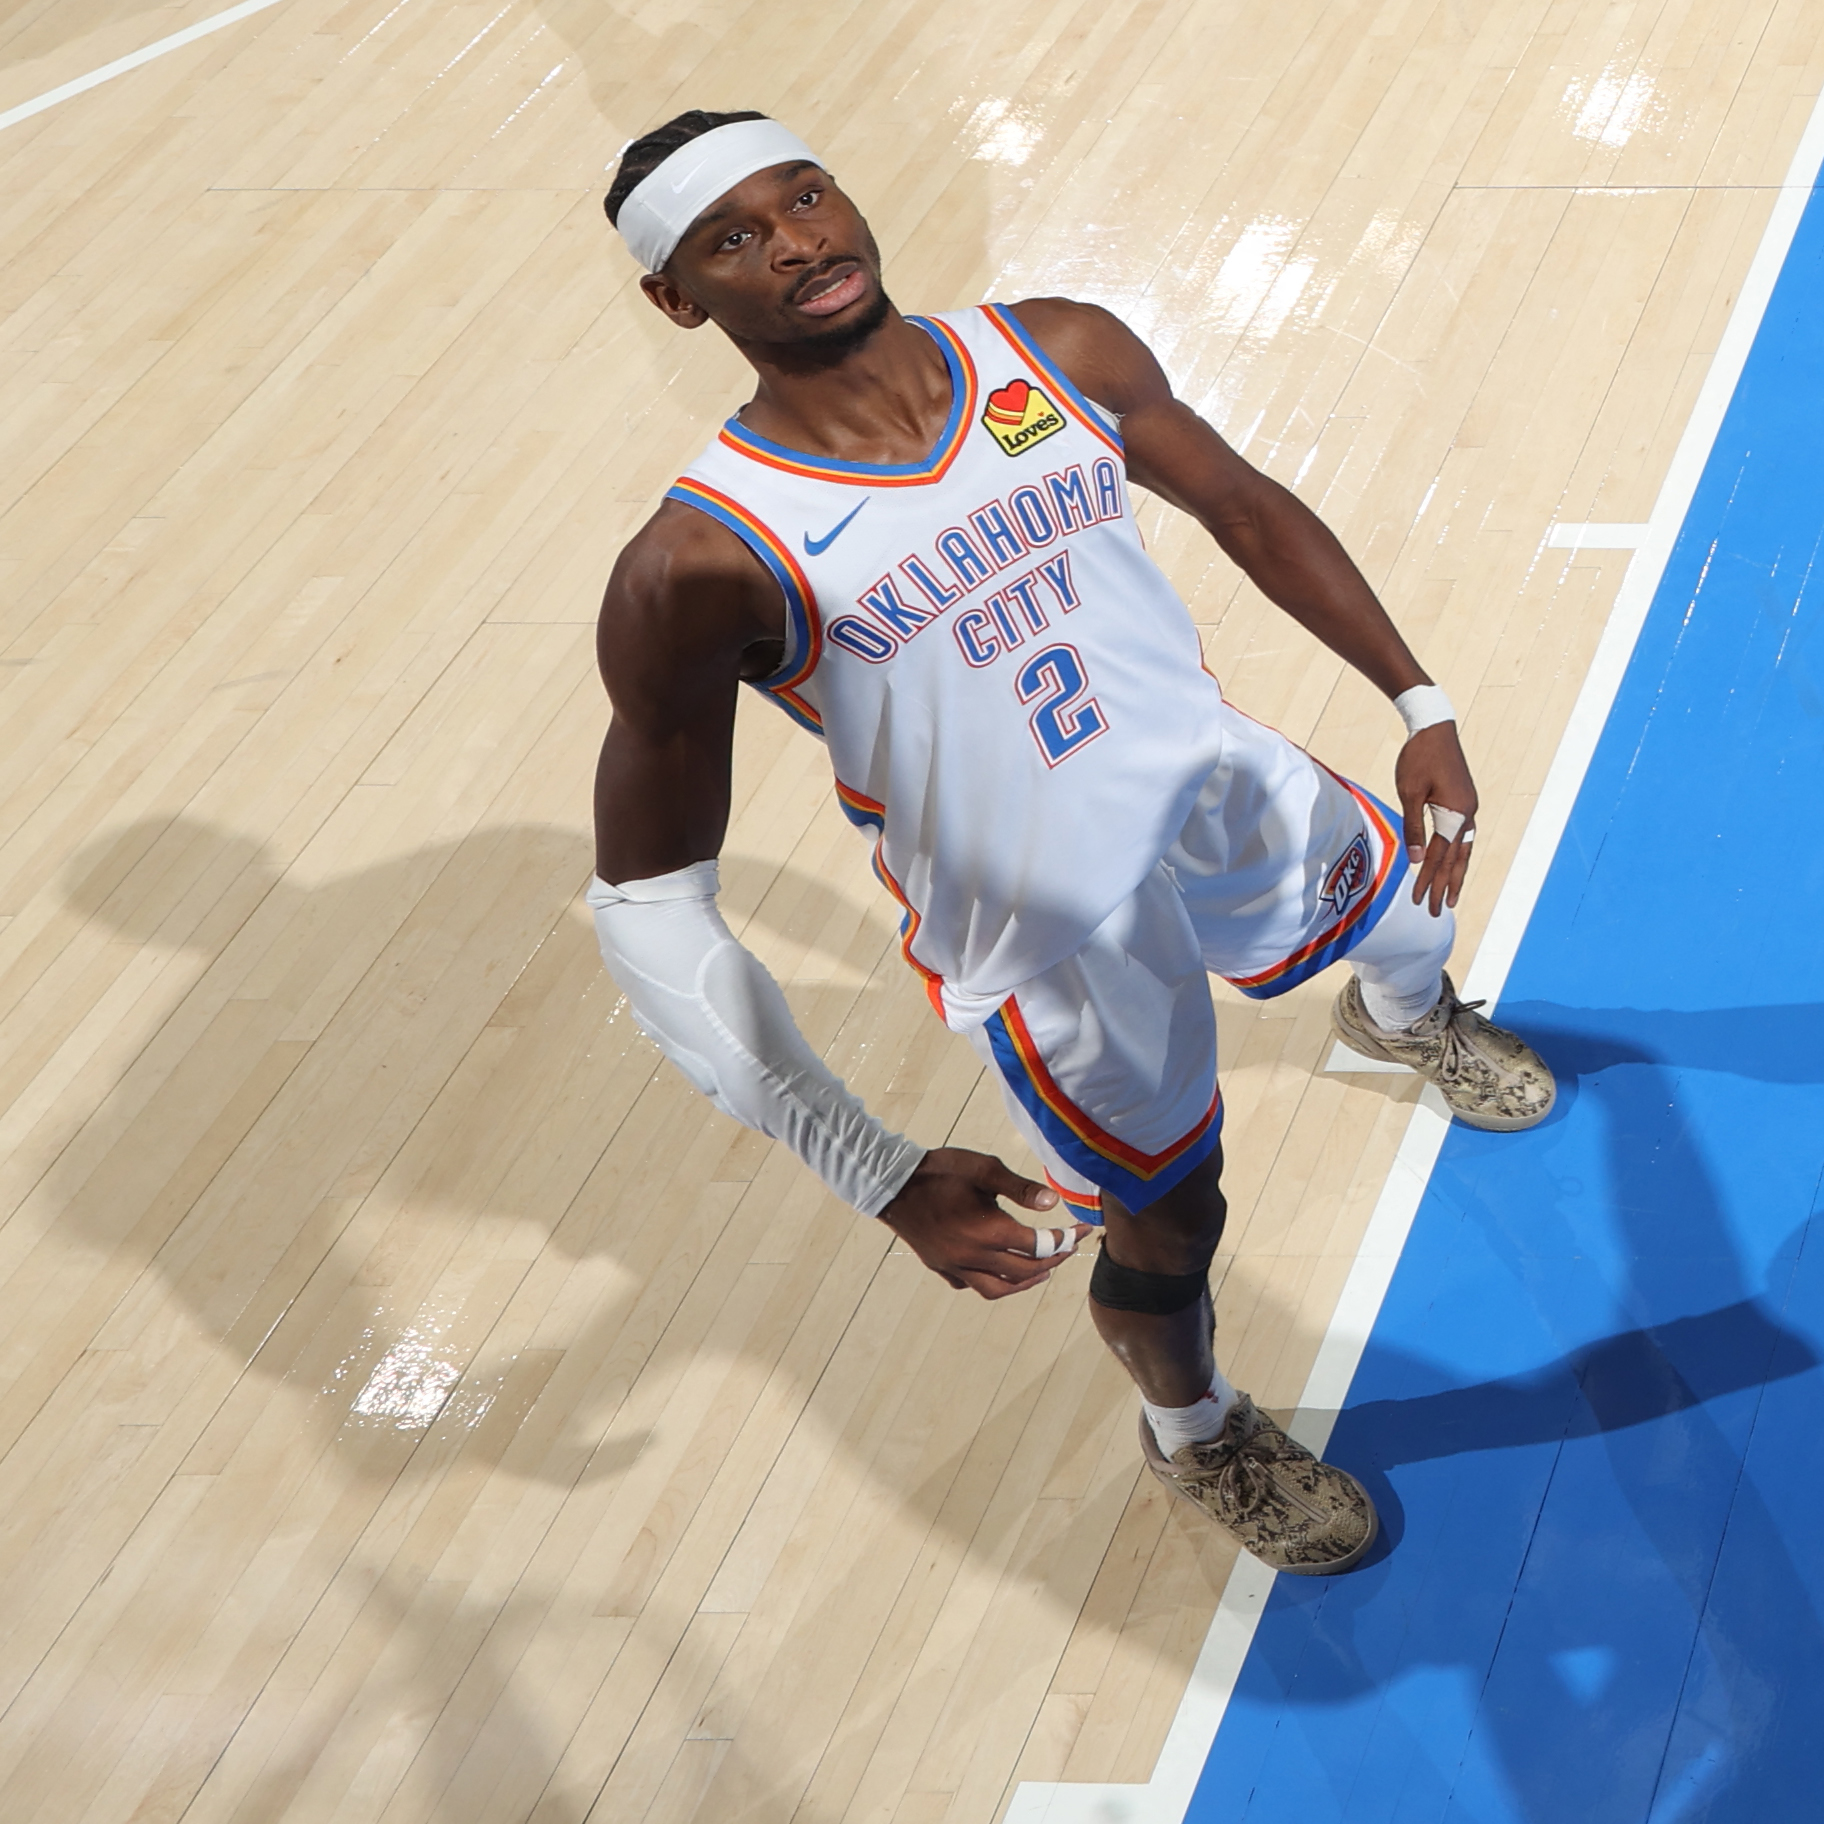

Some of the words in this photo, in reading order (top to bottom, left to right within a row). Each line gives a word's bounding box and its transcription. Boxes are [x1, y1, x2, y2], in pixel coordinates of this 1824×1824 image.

[826, 455, 1124, 666] OKLAHOMA
[953, 549, 1082, 668] CITY
[1014, 642, 1110, 770] 2
